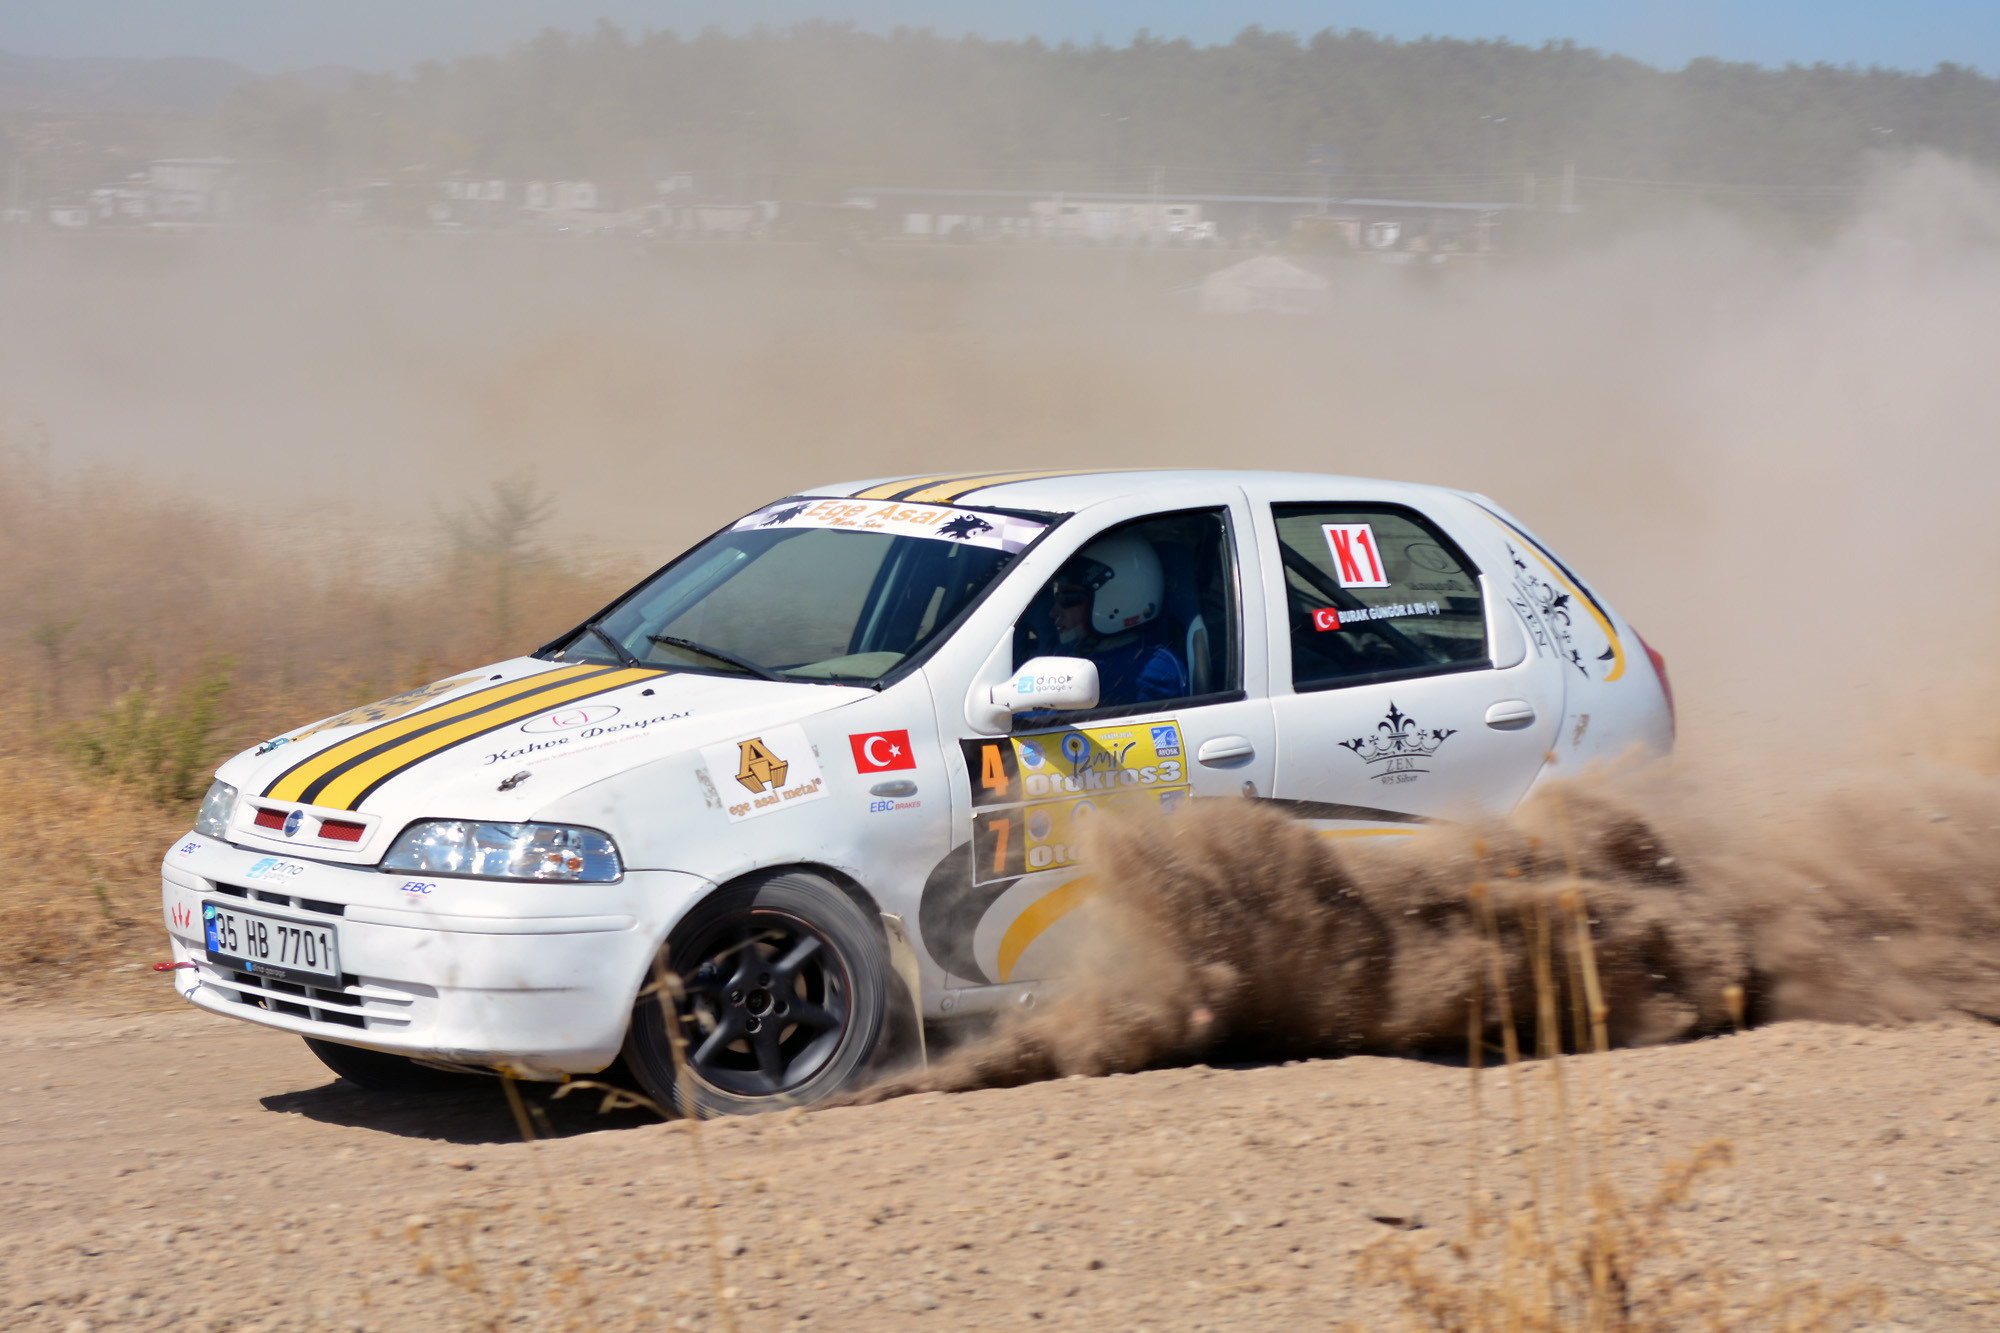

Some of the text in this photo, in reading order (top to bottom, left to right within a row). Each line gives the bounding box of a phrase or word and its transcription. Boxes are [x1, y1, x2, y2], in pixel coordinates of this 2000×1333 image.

[804, 501, 868, 520] Ege
[866, 504, 954, 525] Asal
[1329, 529, 1382, 582] K1
[1338, 608, 1370, 623] BURAK
[483, 738, 569, 765] Kahve
[982, 744, 1009, 796] 4
[1025, 760, 1182, 796] otokros3
[1386, 757, 1414, 773] ZEN
[729, 802, 752, 816] ege
[754, 790, 781, 809] asal
[870, 800, 921, 813] EBC BRAKES
[988, 818, 1010, 873] 7
[400, 881, 436, 894] EBC
[216, 912, 329, 970] 35 HB 7701
